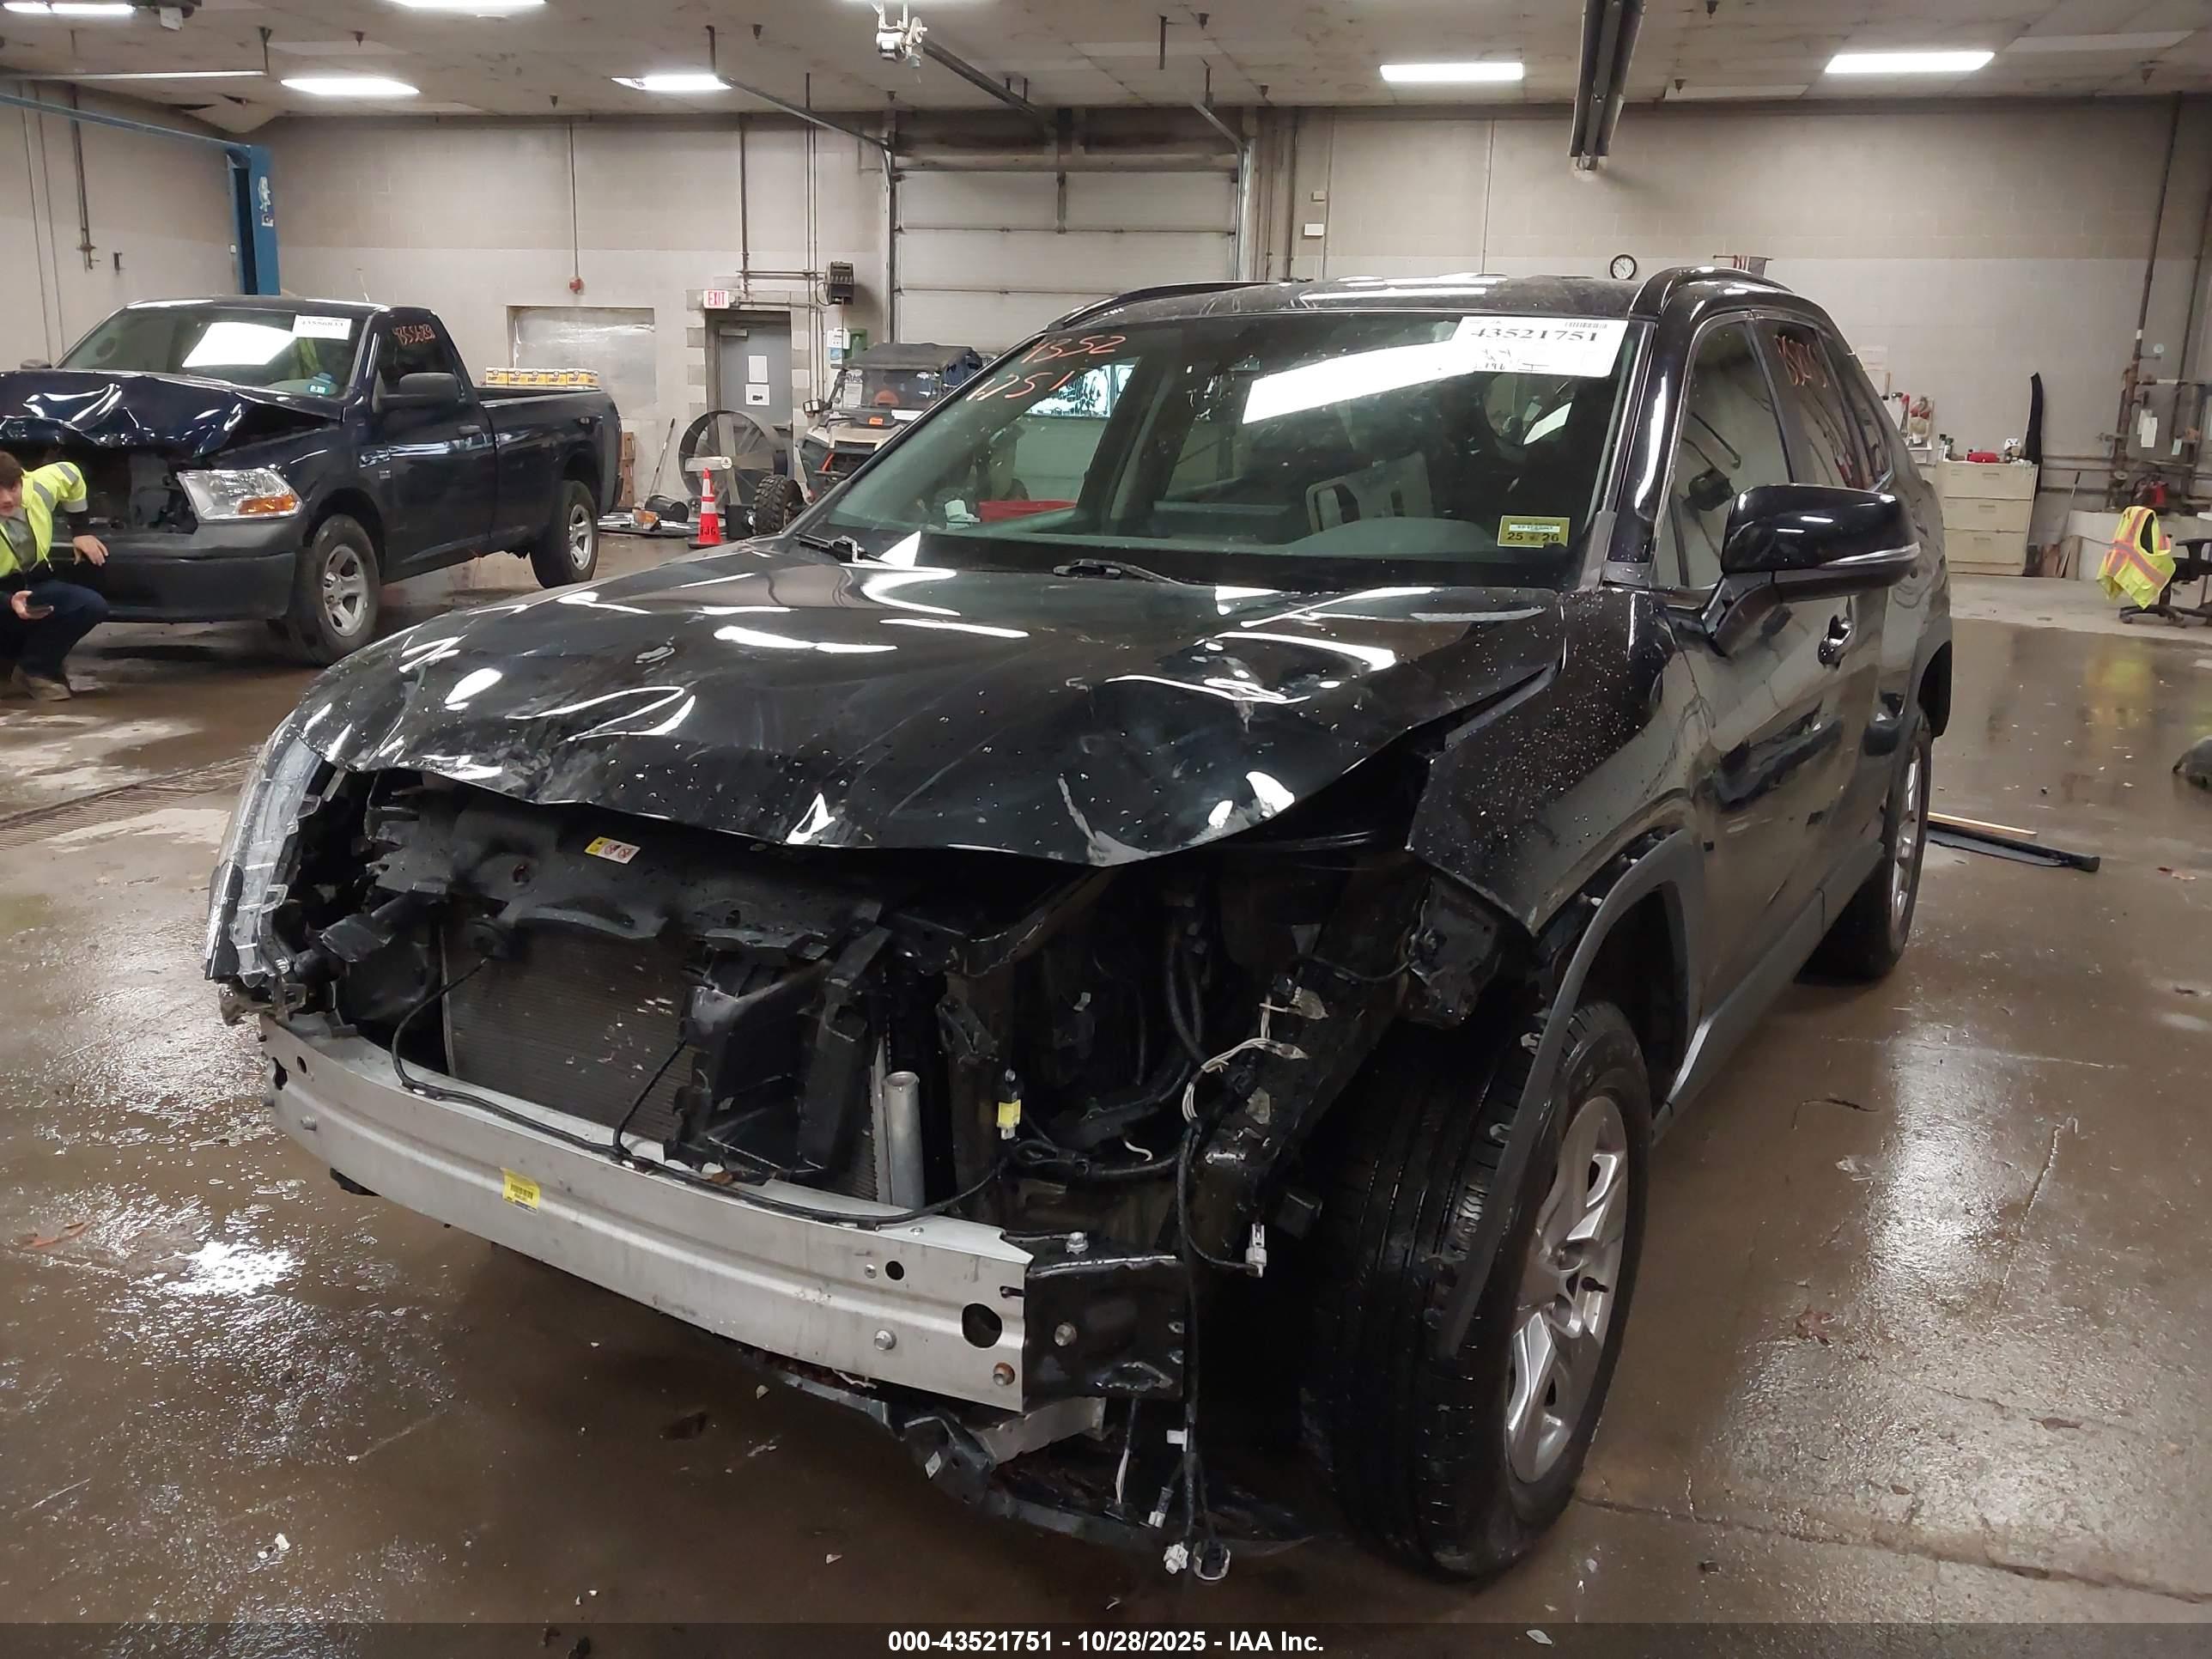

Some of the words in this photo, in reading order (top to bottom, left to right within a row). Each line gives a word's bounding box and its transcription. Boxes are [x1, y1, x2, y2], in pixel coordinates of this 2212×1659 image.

[708, 291, 726, 307] EXIT
[1471, 328, 1597, 342] 43521751
[1507, 532, 1523, 541] 25
